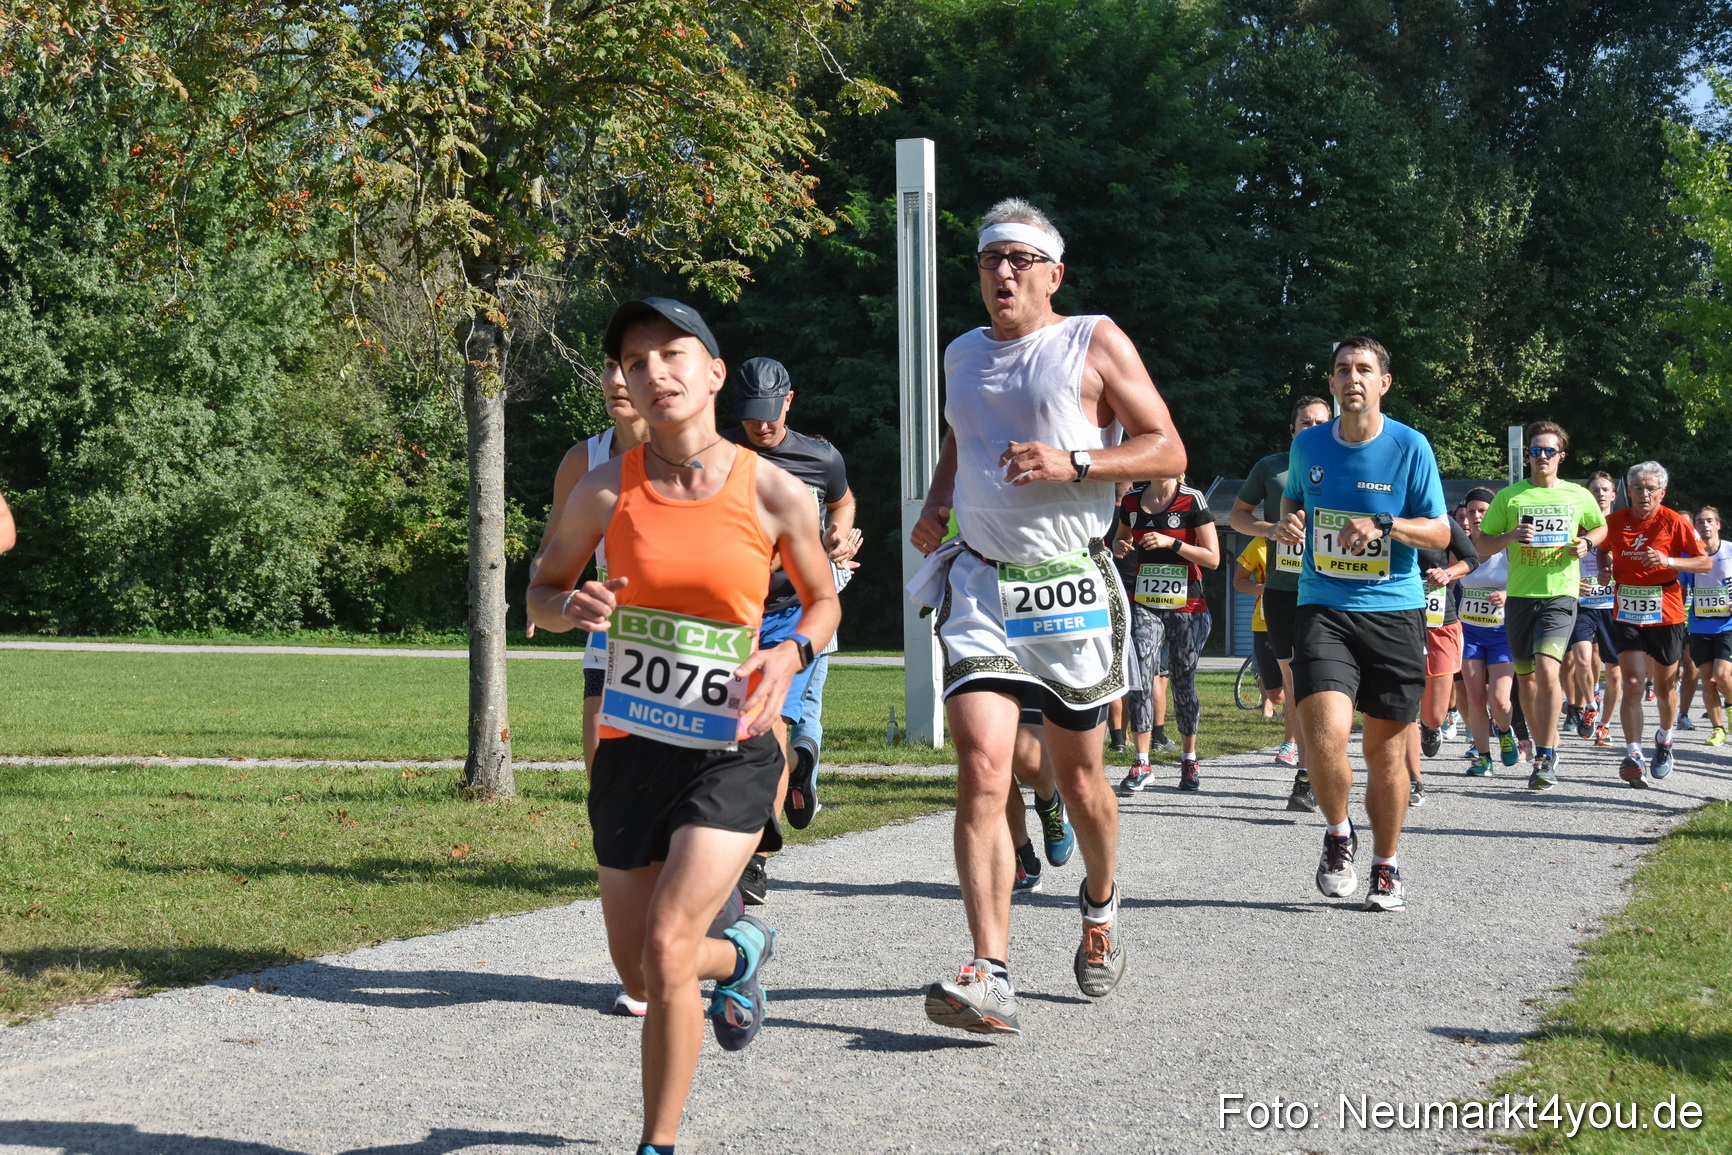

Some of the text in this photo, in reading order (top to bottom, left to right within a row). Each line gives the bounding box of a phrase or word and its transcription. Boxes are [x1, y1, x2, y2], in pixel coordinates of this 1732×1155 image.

[1357, 481, 1392, 492] BOCK
[1523, 506, 1566, 516] BOCK
[1320, 511, 1350, 528] BO
[1534, 519, 1563, 532] 542
[1521, 549, 1564, 559] PREMIUM
[1330, 560, 1369, 572] PETER
[1521, 558, 1563, 568] REISEN
[1142, 566, 1184, 577] BOCK
[1142, 579, 1182, 594] 1220
[1586, 585, 1612, 597] 450
[1621, 586, 1661, 597] BOCK
[1013, 578, 1097, 613] 2008
[1145, 596, 1175, 605] SABINE
[1466, 590, 1488, 599] BOC
[1465, 600, 1499, 615] 1157
[1622, 598, 1657, 612] 2133
[1698, 596, 1726, 607] 1136
[1463, 614, 1498, 624] CHRISTINA
[1624, 613, 1655, 621] MICHAEL
[1032, 616, 1086, 633] PETER
[618, 610, 742, 659] BOCK
[621, 648, 731, 706] 2076
[628, 701, 706, 734] NICOLE
